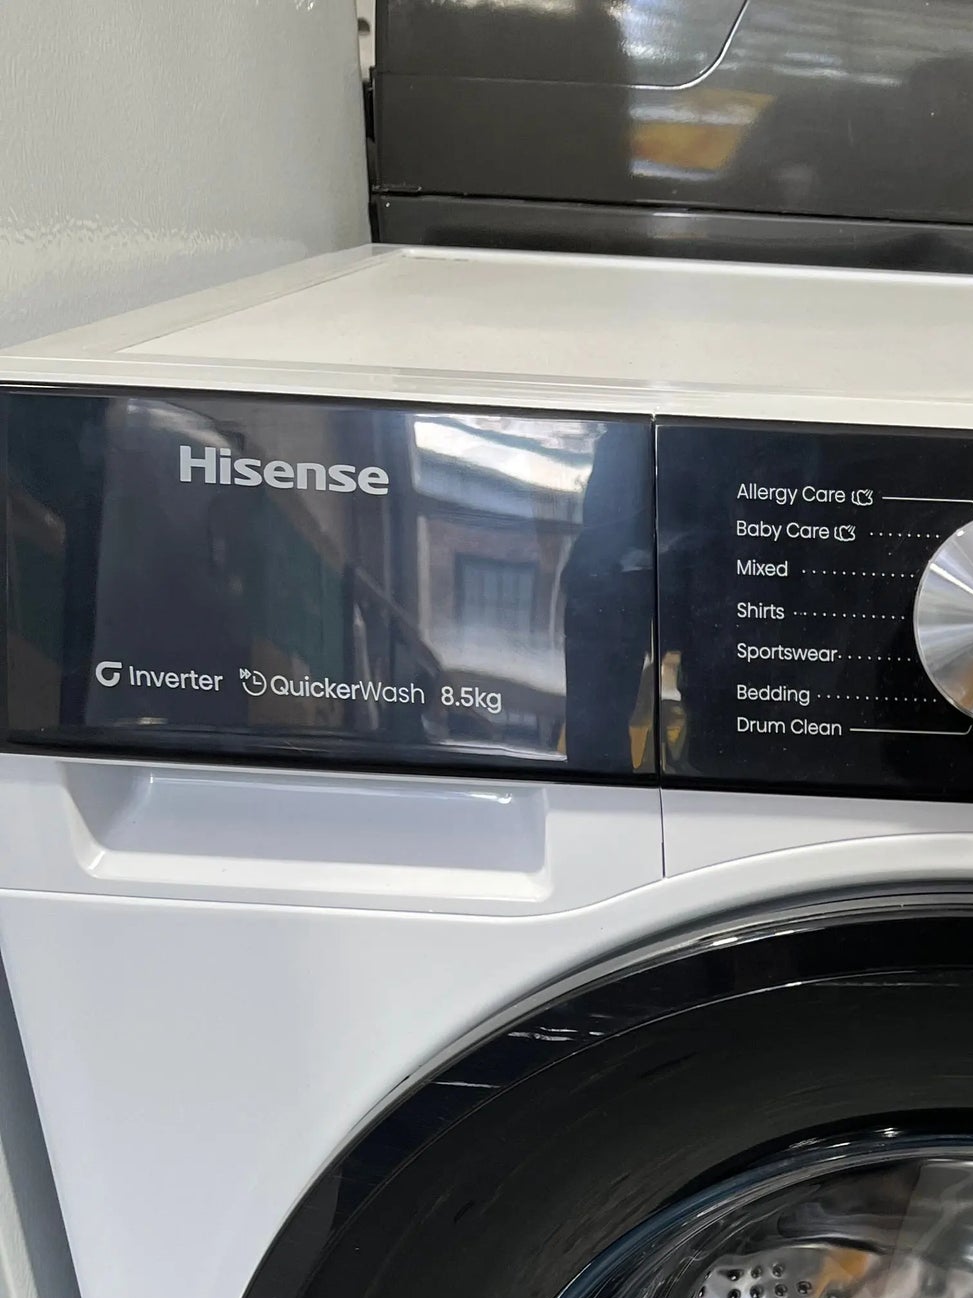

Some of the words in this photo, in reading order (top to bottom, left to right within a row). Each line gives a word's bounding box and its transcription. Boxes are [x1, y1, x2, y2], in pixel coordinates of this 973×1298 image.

[179, 445, 390, 496] Hisense
[736, 483, 798, 505] Allergy
[802, 485, 846, 503] Care
[736, 520, 782, 541] Baby
[786, 522, 830, 539] Care
[736, 559, 789, 577] Mixed
[736, 602, 785, 620] Shirts
[736, 642, 838, 663] Sportswear
[128, 665, 223, 692] Inverter
[269, 674, 425, 705] QuickerWash
[440, 686, 502, 714] 8.5kg
[736, 684, 811, 706] Bedding
[736, 716, 786, 734] Drum
[790, 718, 842, 736] Clean
